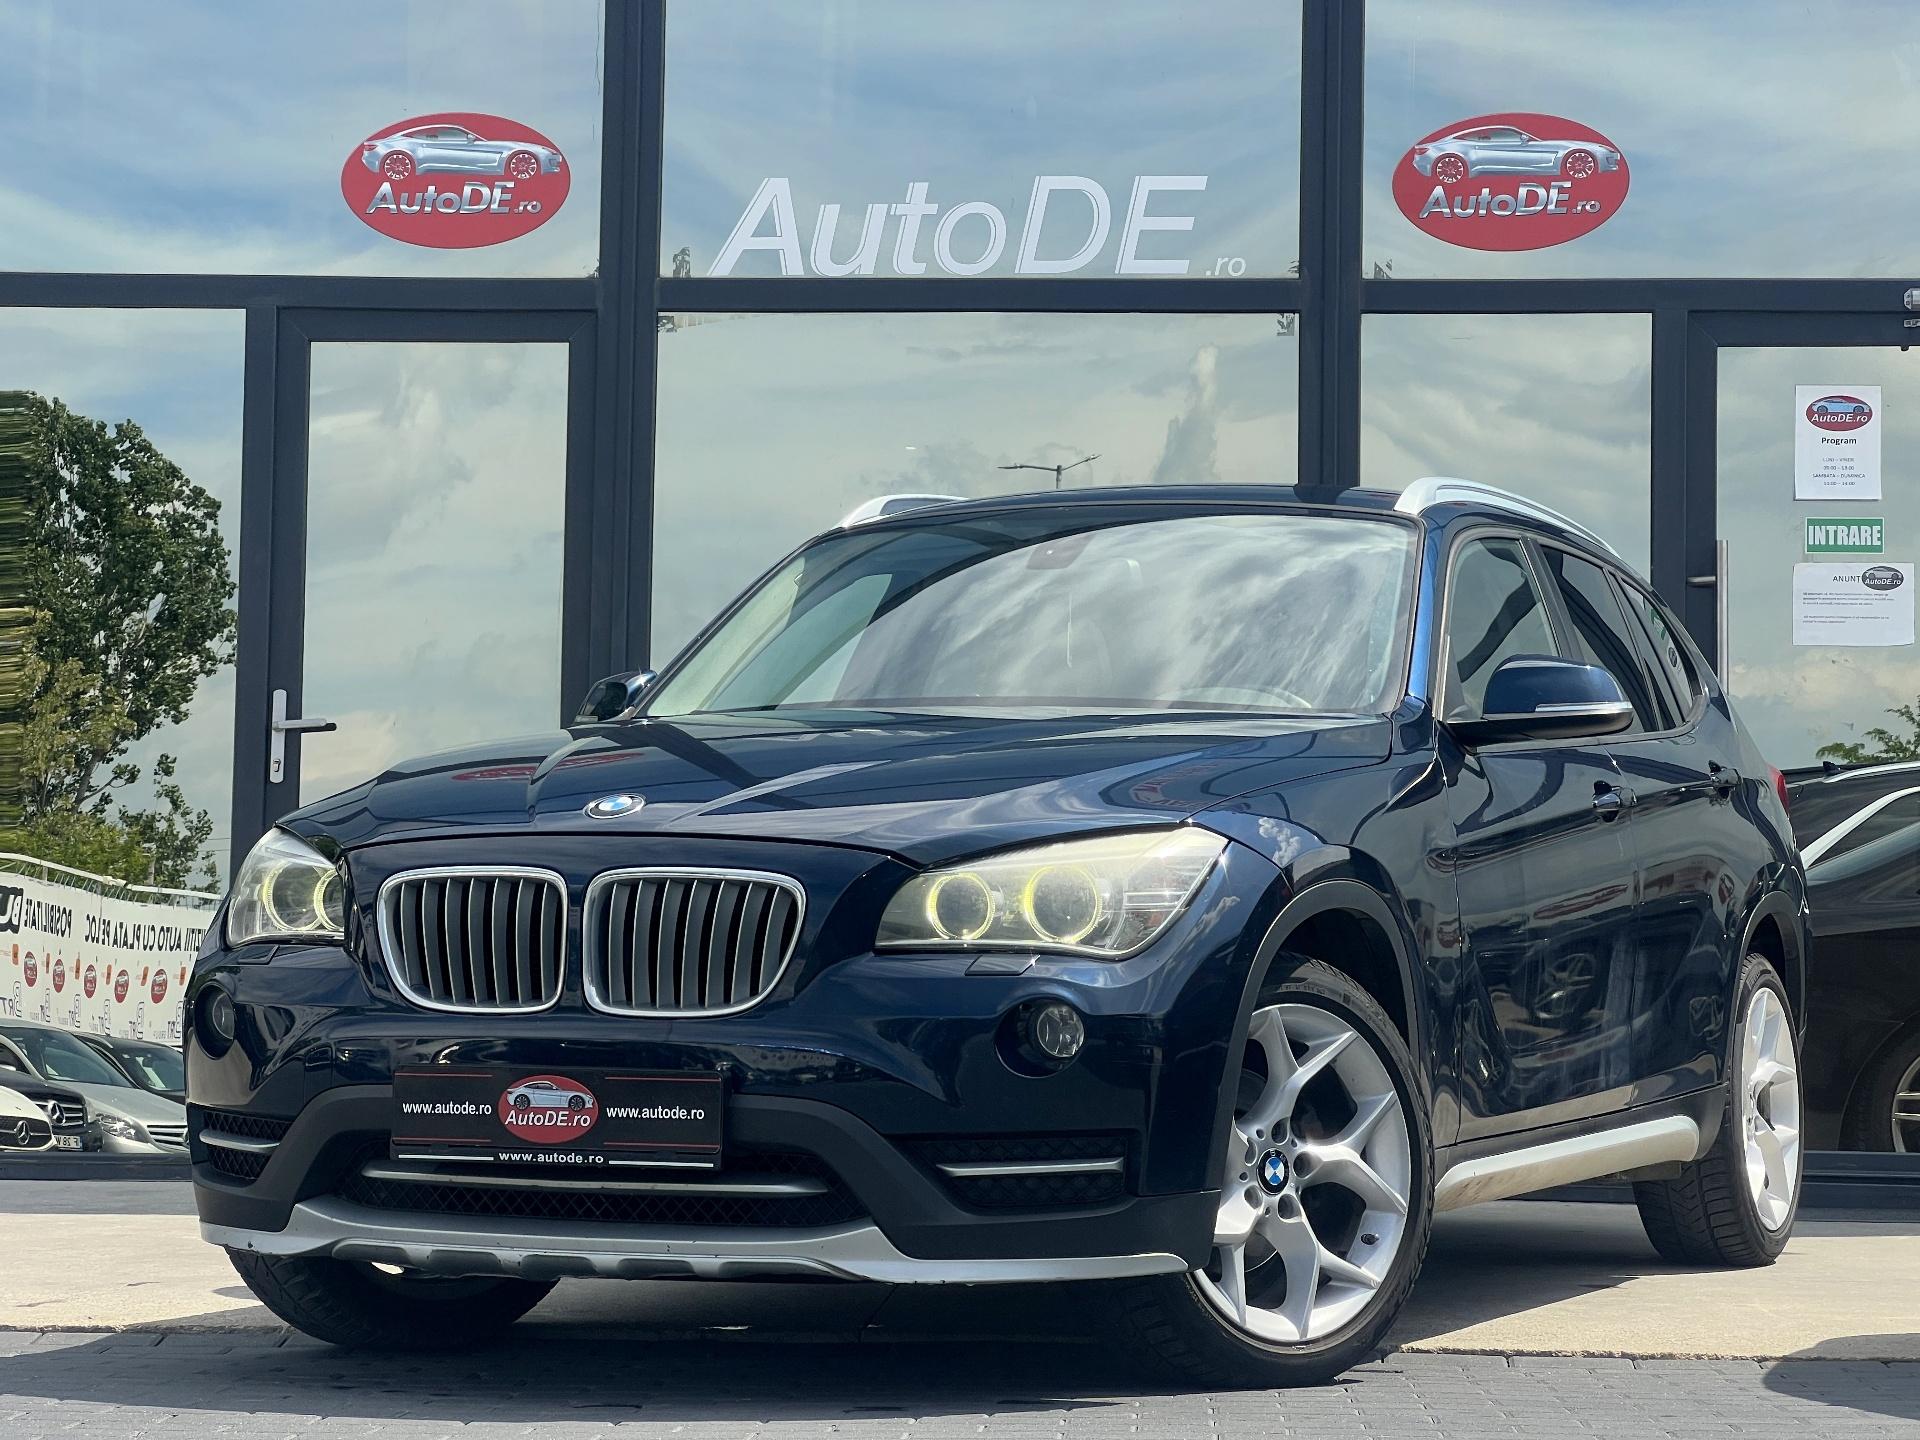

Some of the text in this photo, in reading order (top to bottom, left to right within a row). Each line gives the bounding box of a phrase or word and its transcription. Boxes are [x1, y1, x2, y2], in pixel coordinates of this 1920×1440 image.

[1811, 413, 1868, 423] AutoDE.ro
[1821, 437, 1857, 446] Program
[1808, 525, 1881, 546] INTRARE
[1864, 578, 1902, 586] AutoDE.ro
[402, 1101, 492, 1115] www.autode.ro
[606, 1106, 705, 1120] www.autode.ro
[505, 1110, 591, 1128] AutoDE.ro
[499, 1151, 604, 1164] www.autode.ro
